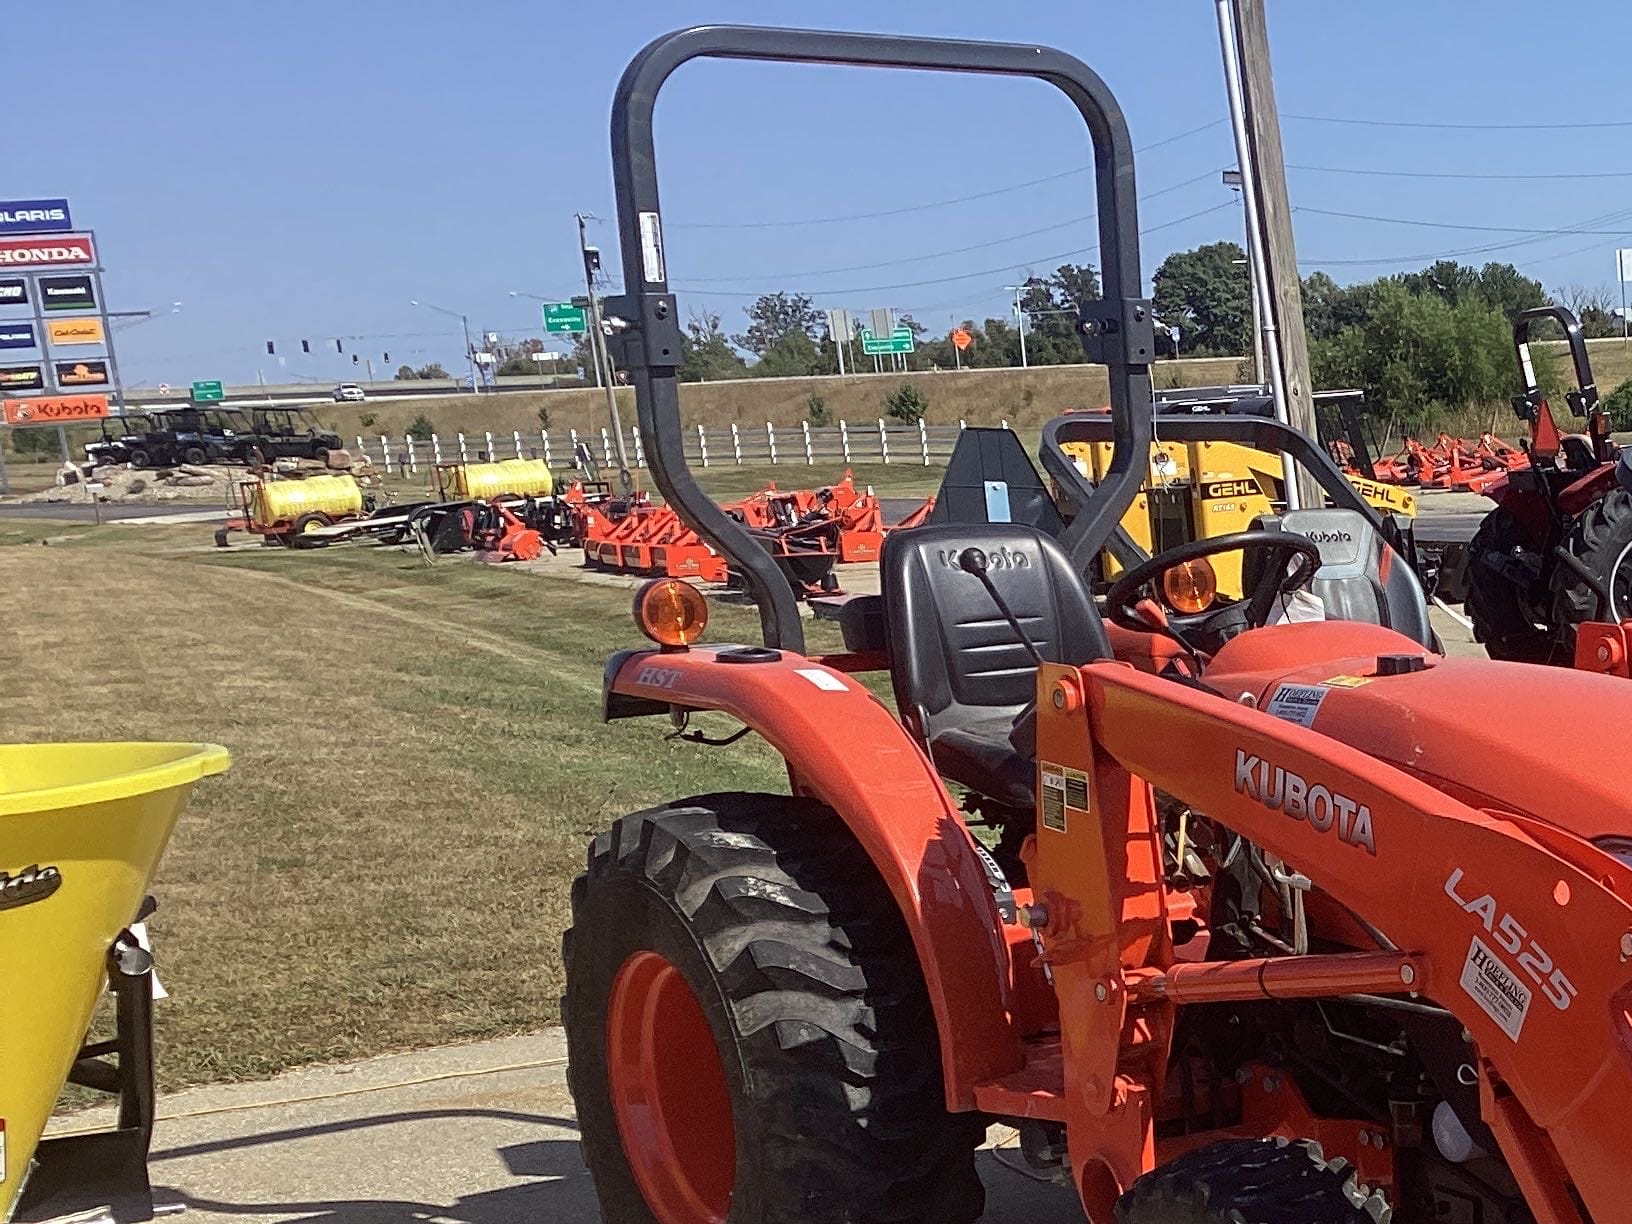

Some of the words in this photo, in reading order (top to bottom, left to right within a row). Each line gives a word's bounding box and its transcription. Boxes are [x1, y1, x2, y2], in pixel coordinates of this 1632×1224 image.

[37, 400, 101, 417] Kubota
[1208, 480, 1257, 497] GEHL
[1233, 748, 1378, 858] KUBOTA
[1444, 867, 1578, 1011] LA525
